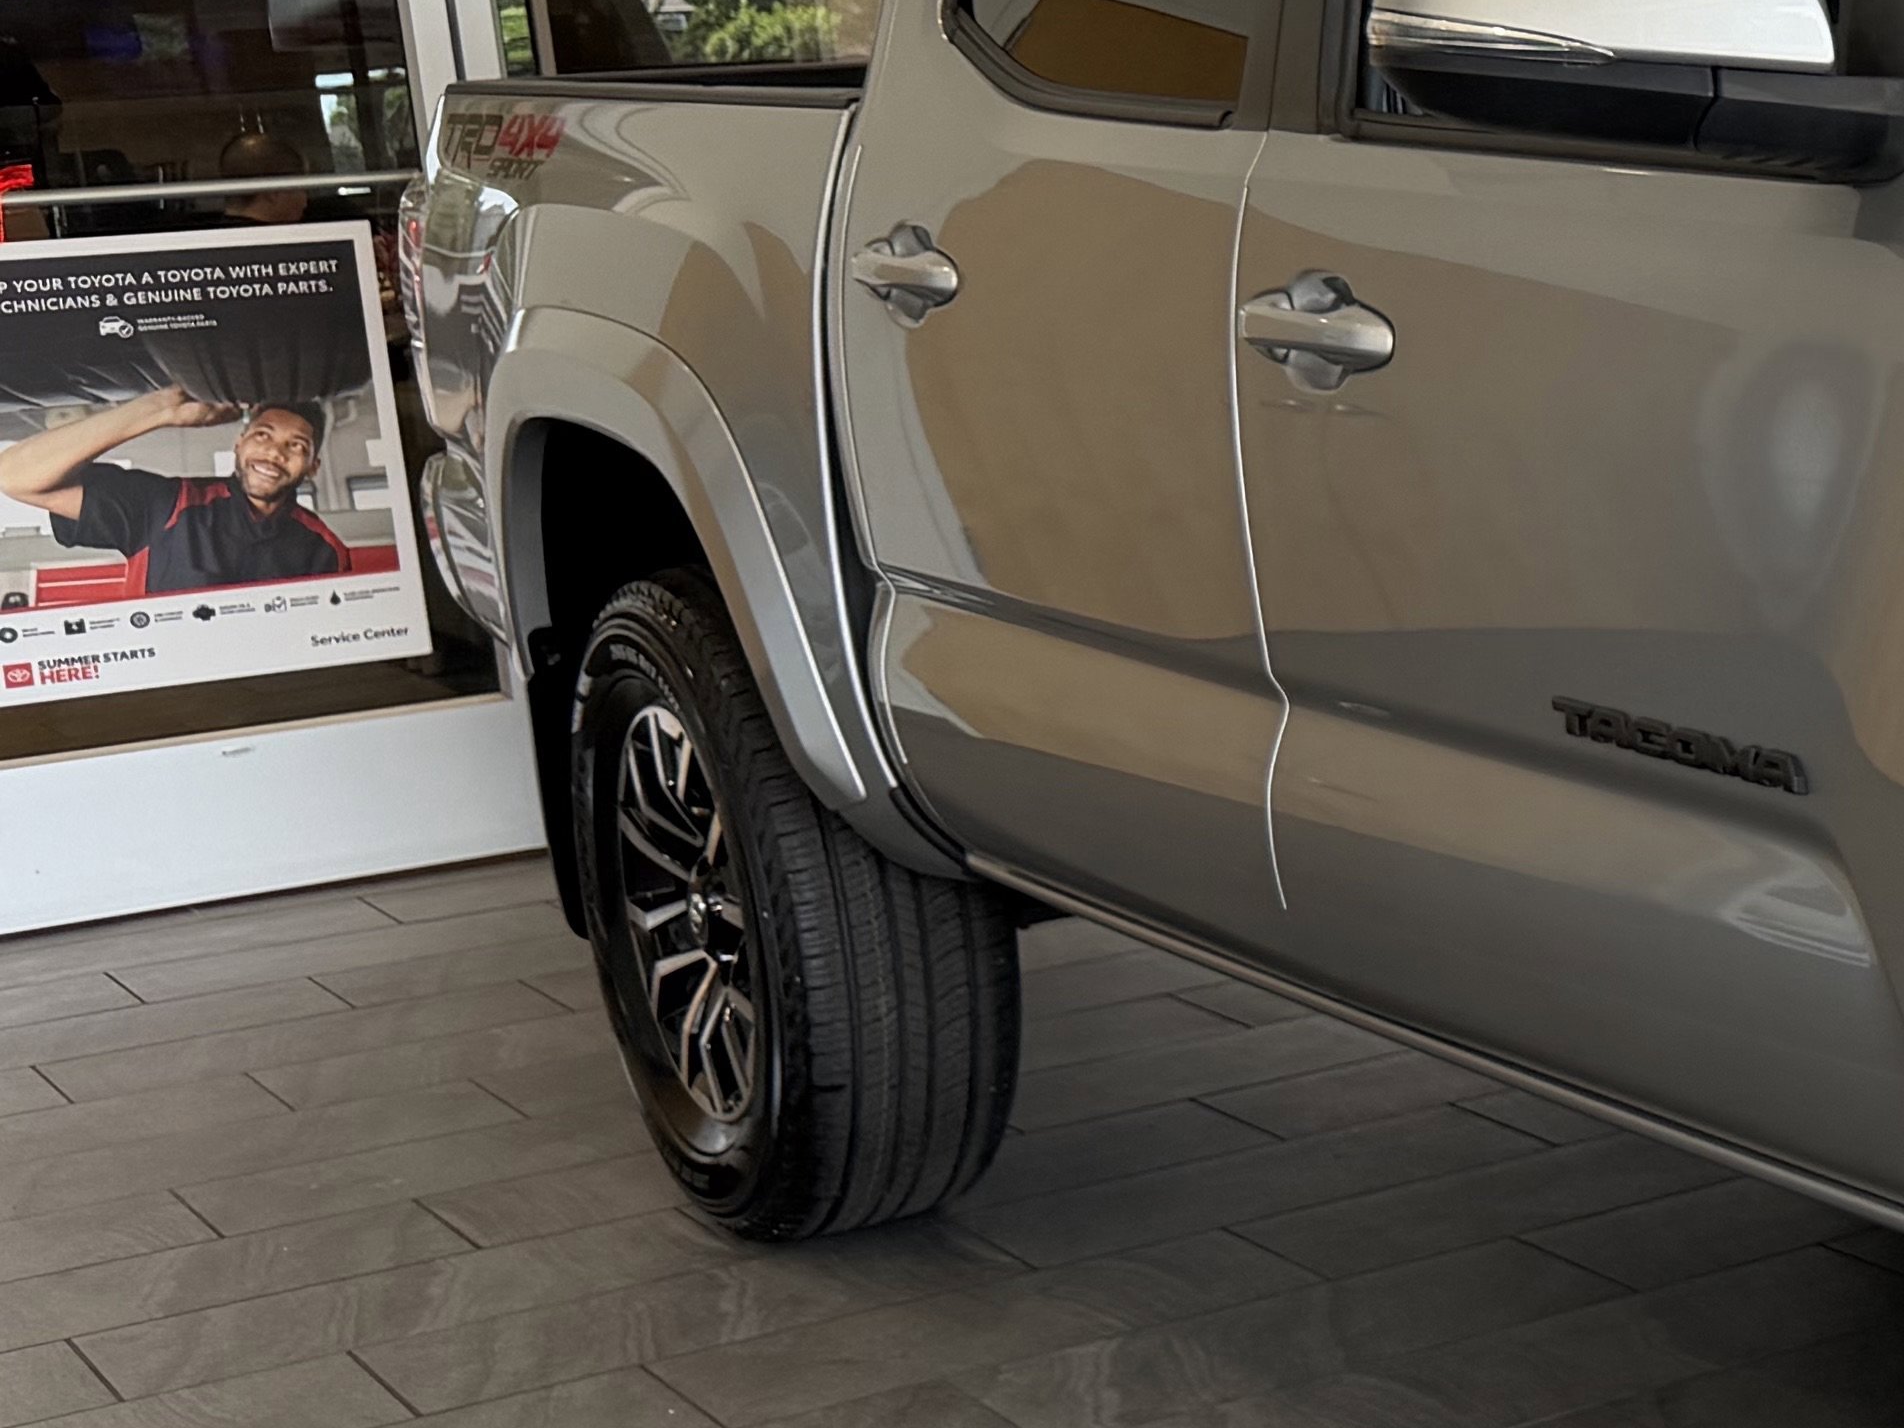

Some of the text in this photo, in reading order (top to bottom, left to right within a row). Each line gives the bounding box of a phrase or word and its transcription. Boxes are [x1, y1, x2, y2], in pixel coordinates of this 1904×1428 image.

[486, 157, 544, 181] SPORT
[13, 276, 64, 294] YOUR
[68, 273, 137, 291] TOYOTA
[141, 272, 154, 286] A
[158, 267, 226, 285] TOYOTA
[229, 263, 273, 280] WITH
[278, 259, 339, 277] EXPERT
[0, 279, 334, 315] CHNICIANS & GENUINE TOYOTA PARTS.
[310, 625, 410, 647] Service Center
[37, 647, 156, 671] SUMMER STARTS
[38, 664, 101, 685] HERE!
[1551, 694, 1810, 796] TACOMA
